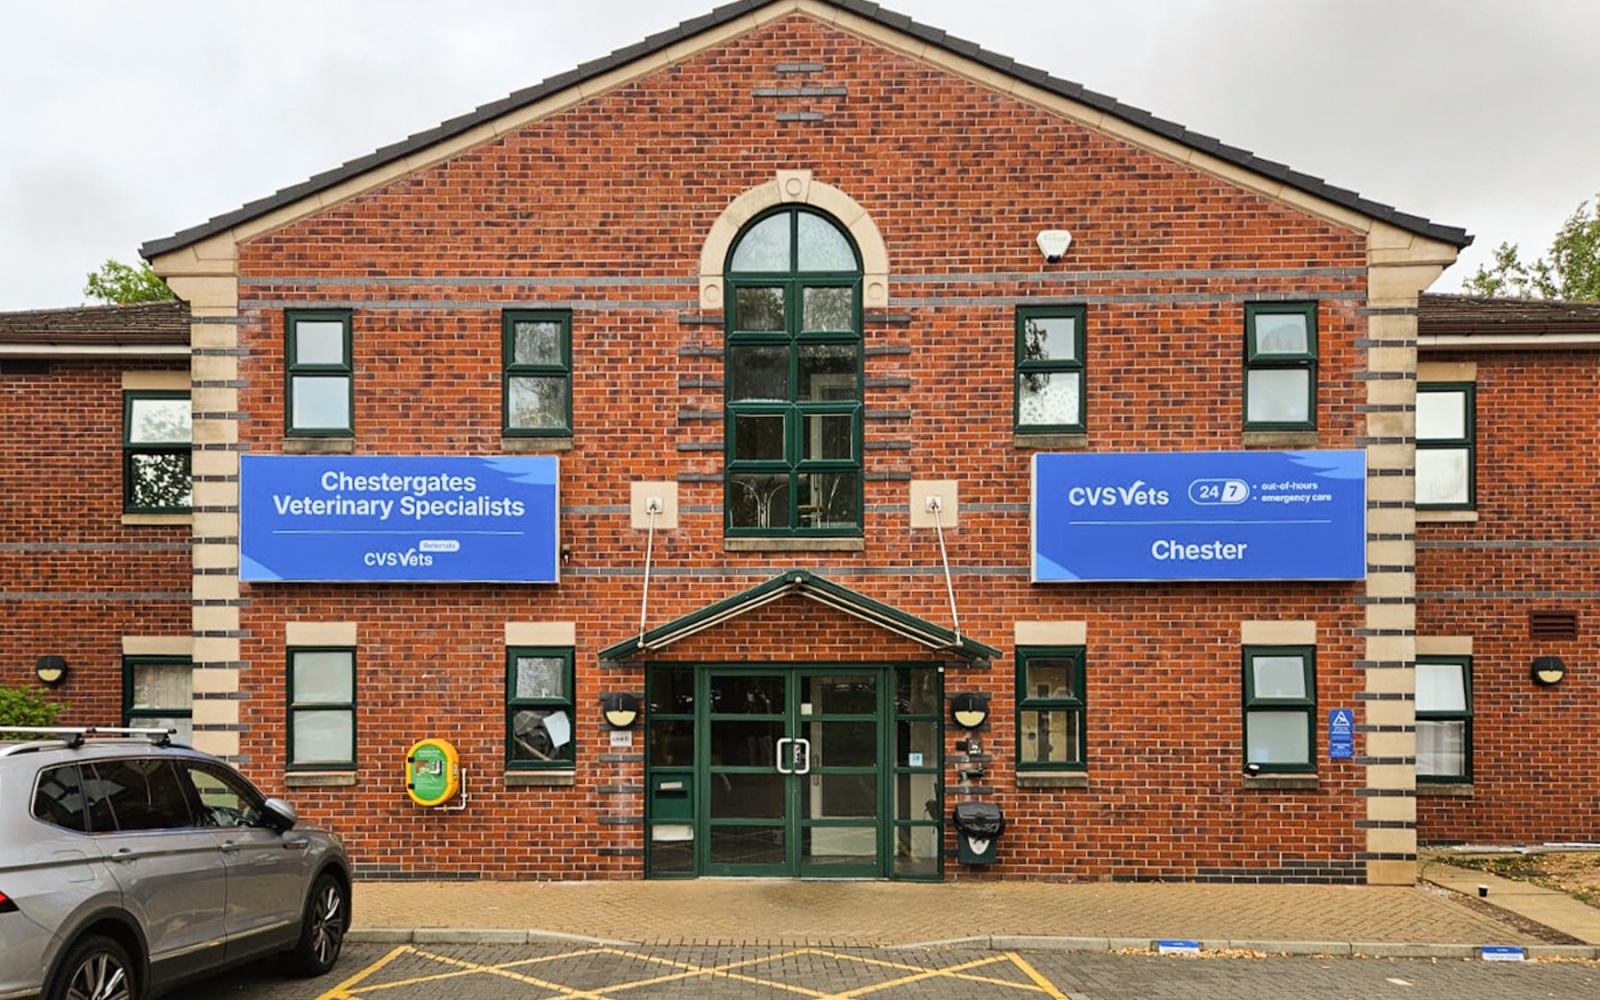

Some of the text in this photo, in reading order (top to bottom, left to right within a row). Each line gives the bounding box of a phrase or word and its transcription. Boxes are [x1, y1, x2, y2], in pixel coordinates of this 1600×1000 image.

[321, 471, 477, 496] Chestergates
[1068, 480, 1169, 506] CVS Vets
[1199, 485, 1238, 498] 24 7
[1261, 481, 1318, 491] out-of-hours
[273, 495, 525, 520] Veterinary Specialists
[1261, 494, 1332, 504] emergency care
[364, 548, 433, 566] CVS Vets
[1151, 539, 1247, 560] Chester
